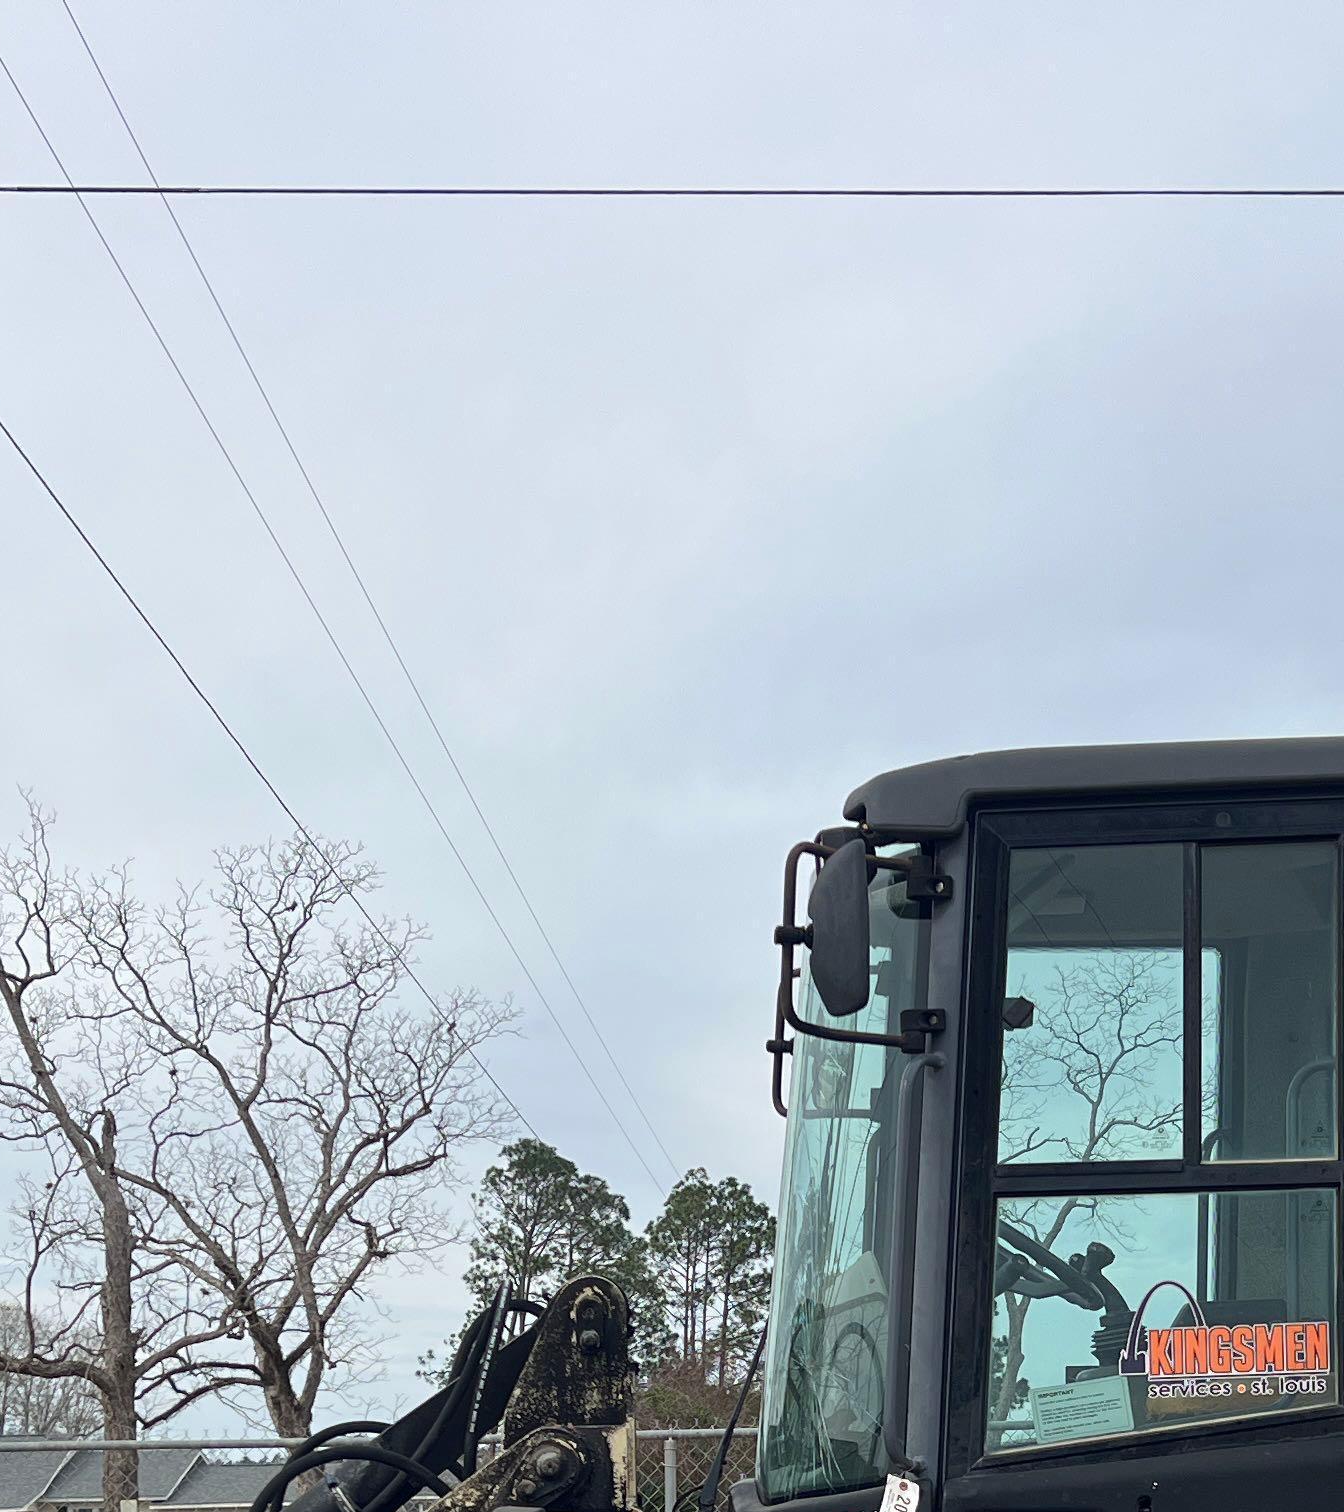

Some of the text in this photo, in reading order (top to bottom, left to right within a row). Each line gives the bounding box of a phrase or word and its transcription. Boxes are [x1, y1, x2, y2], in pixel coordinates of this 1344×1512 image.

[1149, 1323, 1329, 1376] KINGSMEN
[1149, 1377, 1327, 1398] services st. louis
